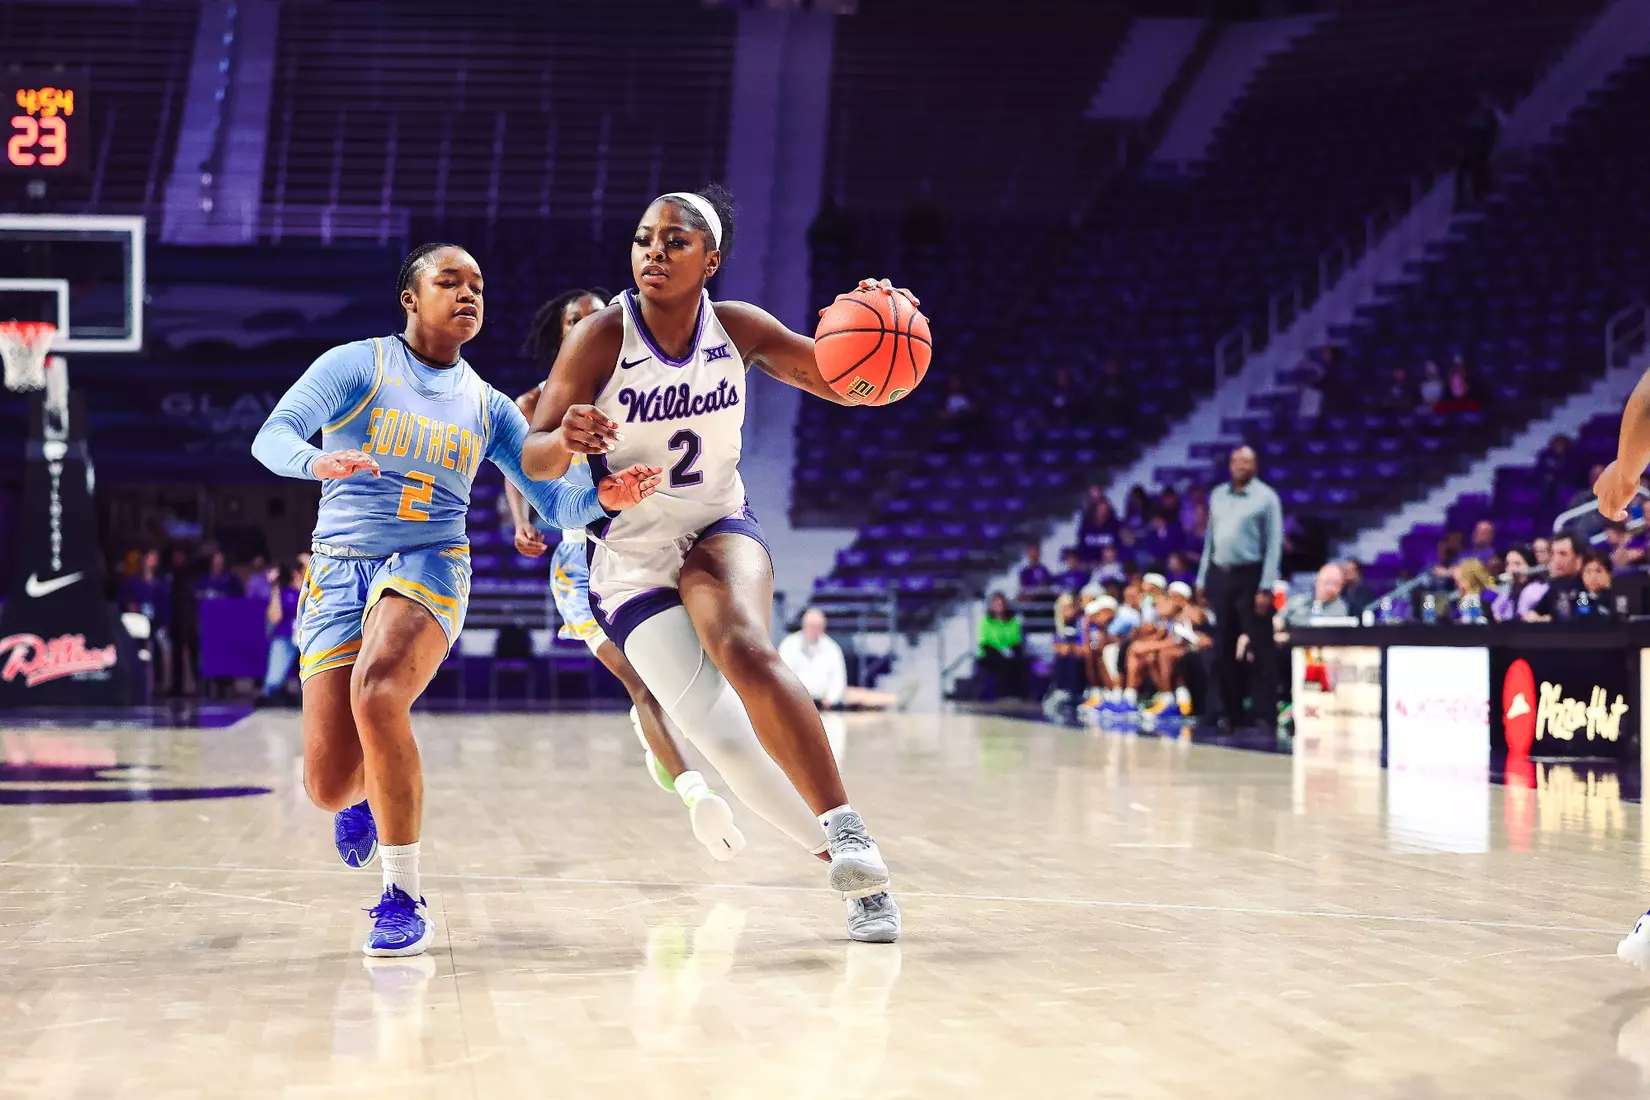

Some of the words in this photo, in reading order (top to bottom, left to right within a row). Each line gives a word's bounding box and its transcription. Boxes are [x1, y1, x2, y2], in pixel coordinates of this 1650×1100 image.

[8, 115, 67, 166] 23
[618, 377, 740, 423] Wildcats
[362, 407, 483, 479] SOUTHERN
[667, 428, 704, 488] 2
[396, 470, 435, 522] 2
[1535, 681, 1588, 741] Pizza
[1586, 685, 1629, 742] Hut
